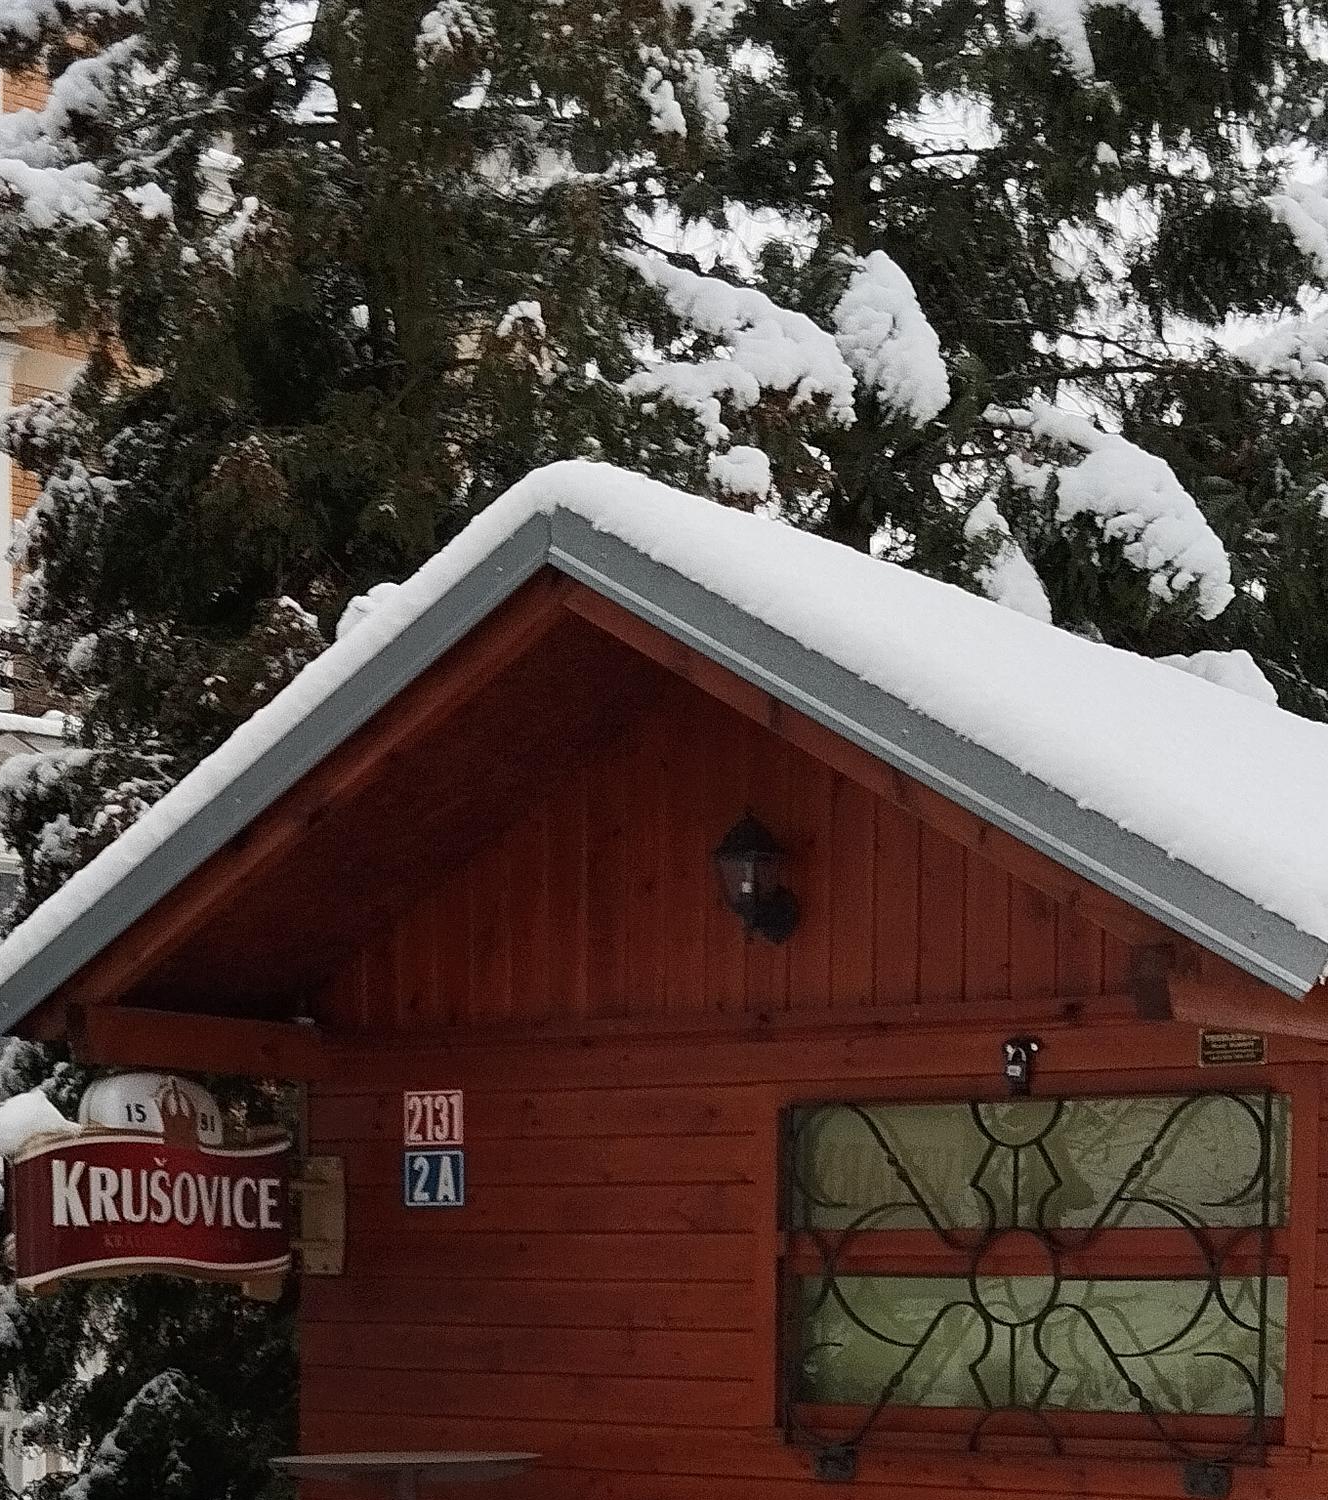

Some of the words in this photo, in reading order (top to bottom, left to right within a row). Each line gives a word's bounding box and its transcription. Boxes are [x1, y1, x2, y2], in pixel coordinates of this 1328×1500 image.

[124, 1103, 147, 1124] 15
[408, 1094, 462, 1141] 2131
[51, 1157, 283, 1231] KRUŠOVICE
